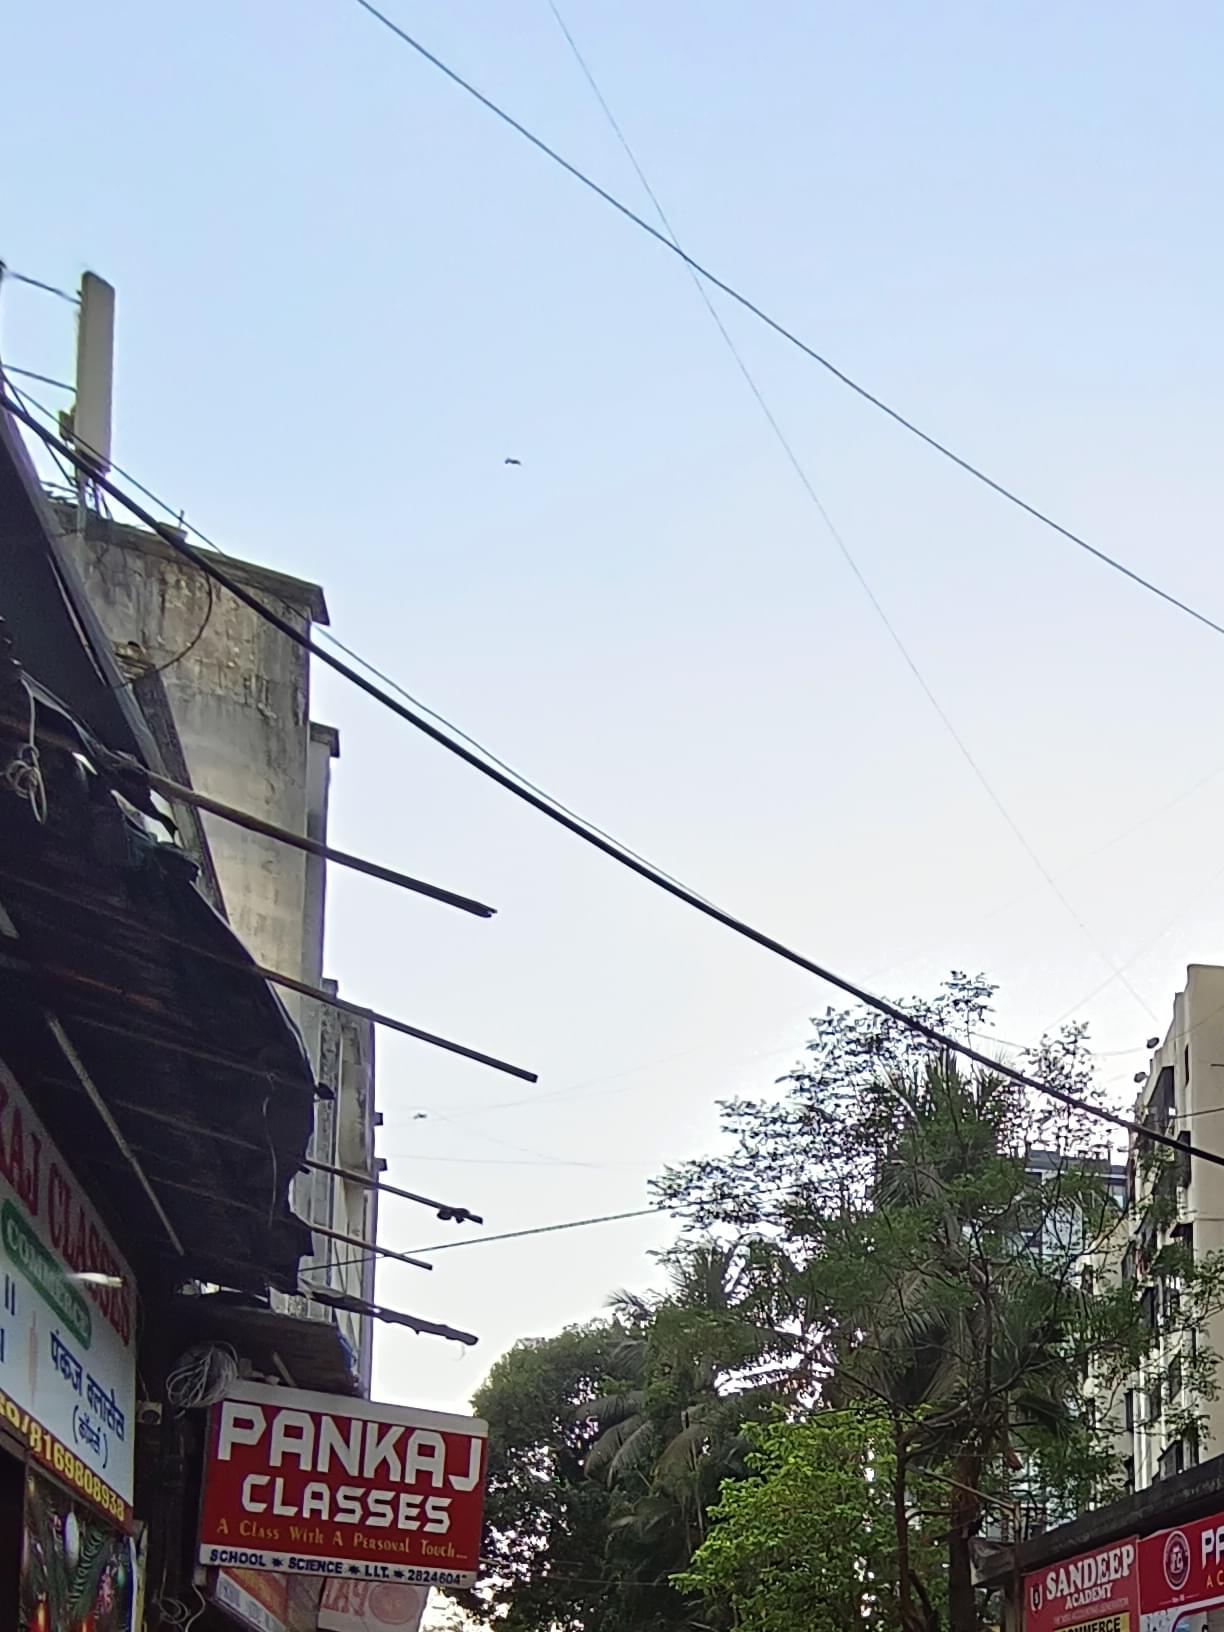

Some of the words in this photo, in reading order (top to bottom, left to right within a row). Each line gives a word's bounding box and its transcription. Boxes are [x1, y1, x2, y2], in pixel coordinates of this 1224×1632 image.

[50, 1330, 83, 1396] पंकज
[217, 1401, 482, 1492] PANKAJ
[241, 1474, 453, 1534] CLASSES
[217, 1519, 229, 1535] A
[332, 1531, 344, 1547] A
[210, 1549, 267, 1567] SCHOOL
[287, 1557, 342, 1574] SCIENCE
[407, 1569, 468, 1585] 2824604
[1046, 1544, 1135, 1600] SANDEEP
[1206, 1575, 1213, 1589] A
[1065, 1582, 1113, 1610] ACADEMY
